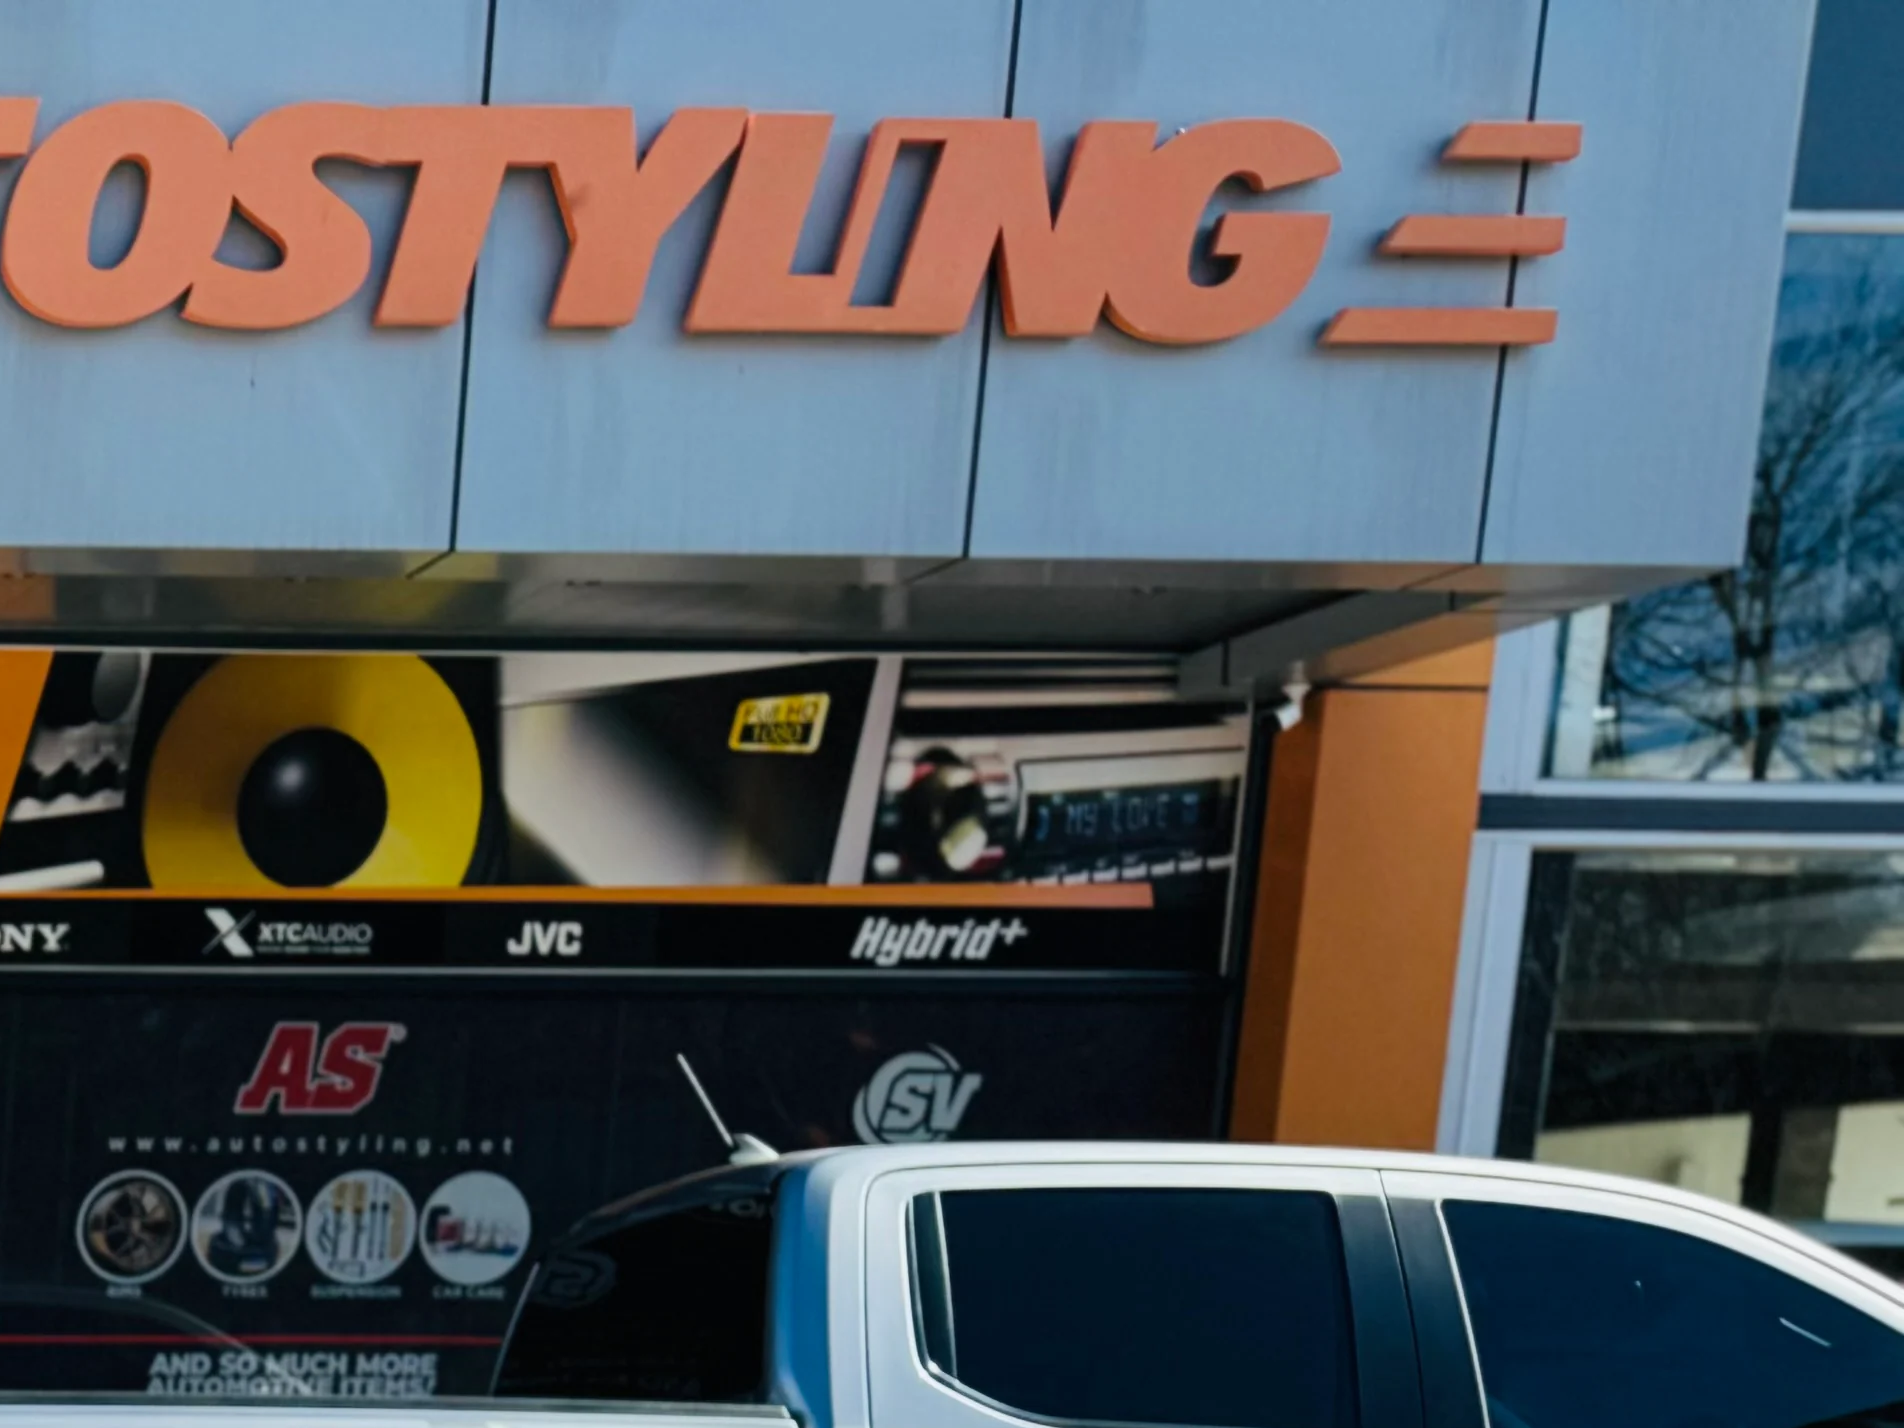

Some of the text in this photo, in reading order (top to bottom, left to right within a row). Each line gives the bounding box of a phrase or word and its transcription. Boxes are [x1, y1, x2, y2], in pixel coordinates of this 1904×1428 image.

[257, 922, 374, 945] XTCAUDIO
[507, 922, 583, 956] JVC
[851, 917, 1028, 966] Hybrid+
[881, 1073, 983, 1131] SV
[108, 1133, 514, 1156] www.autostyling.net
[433, 1286, 504, 1298] CAR CARE
[149, 1353, 438, 1376] AND SO MUCH MORE
[146, 1376, 330, 1398] AUTOMOTIVE
